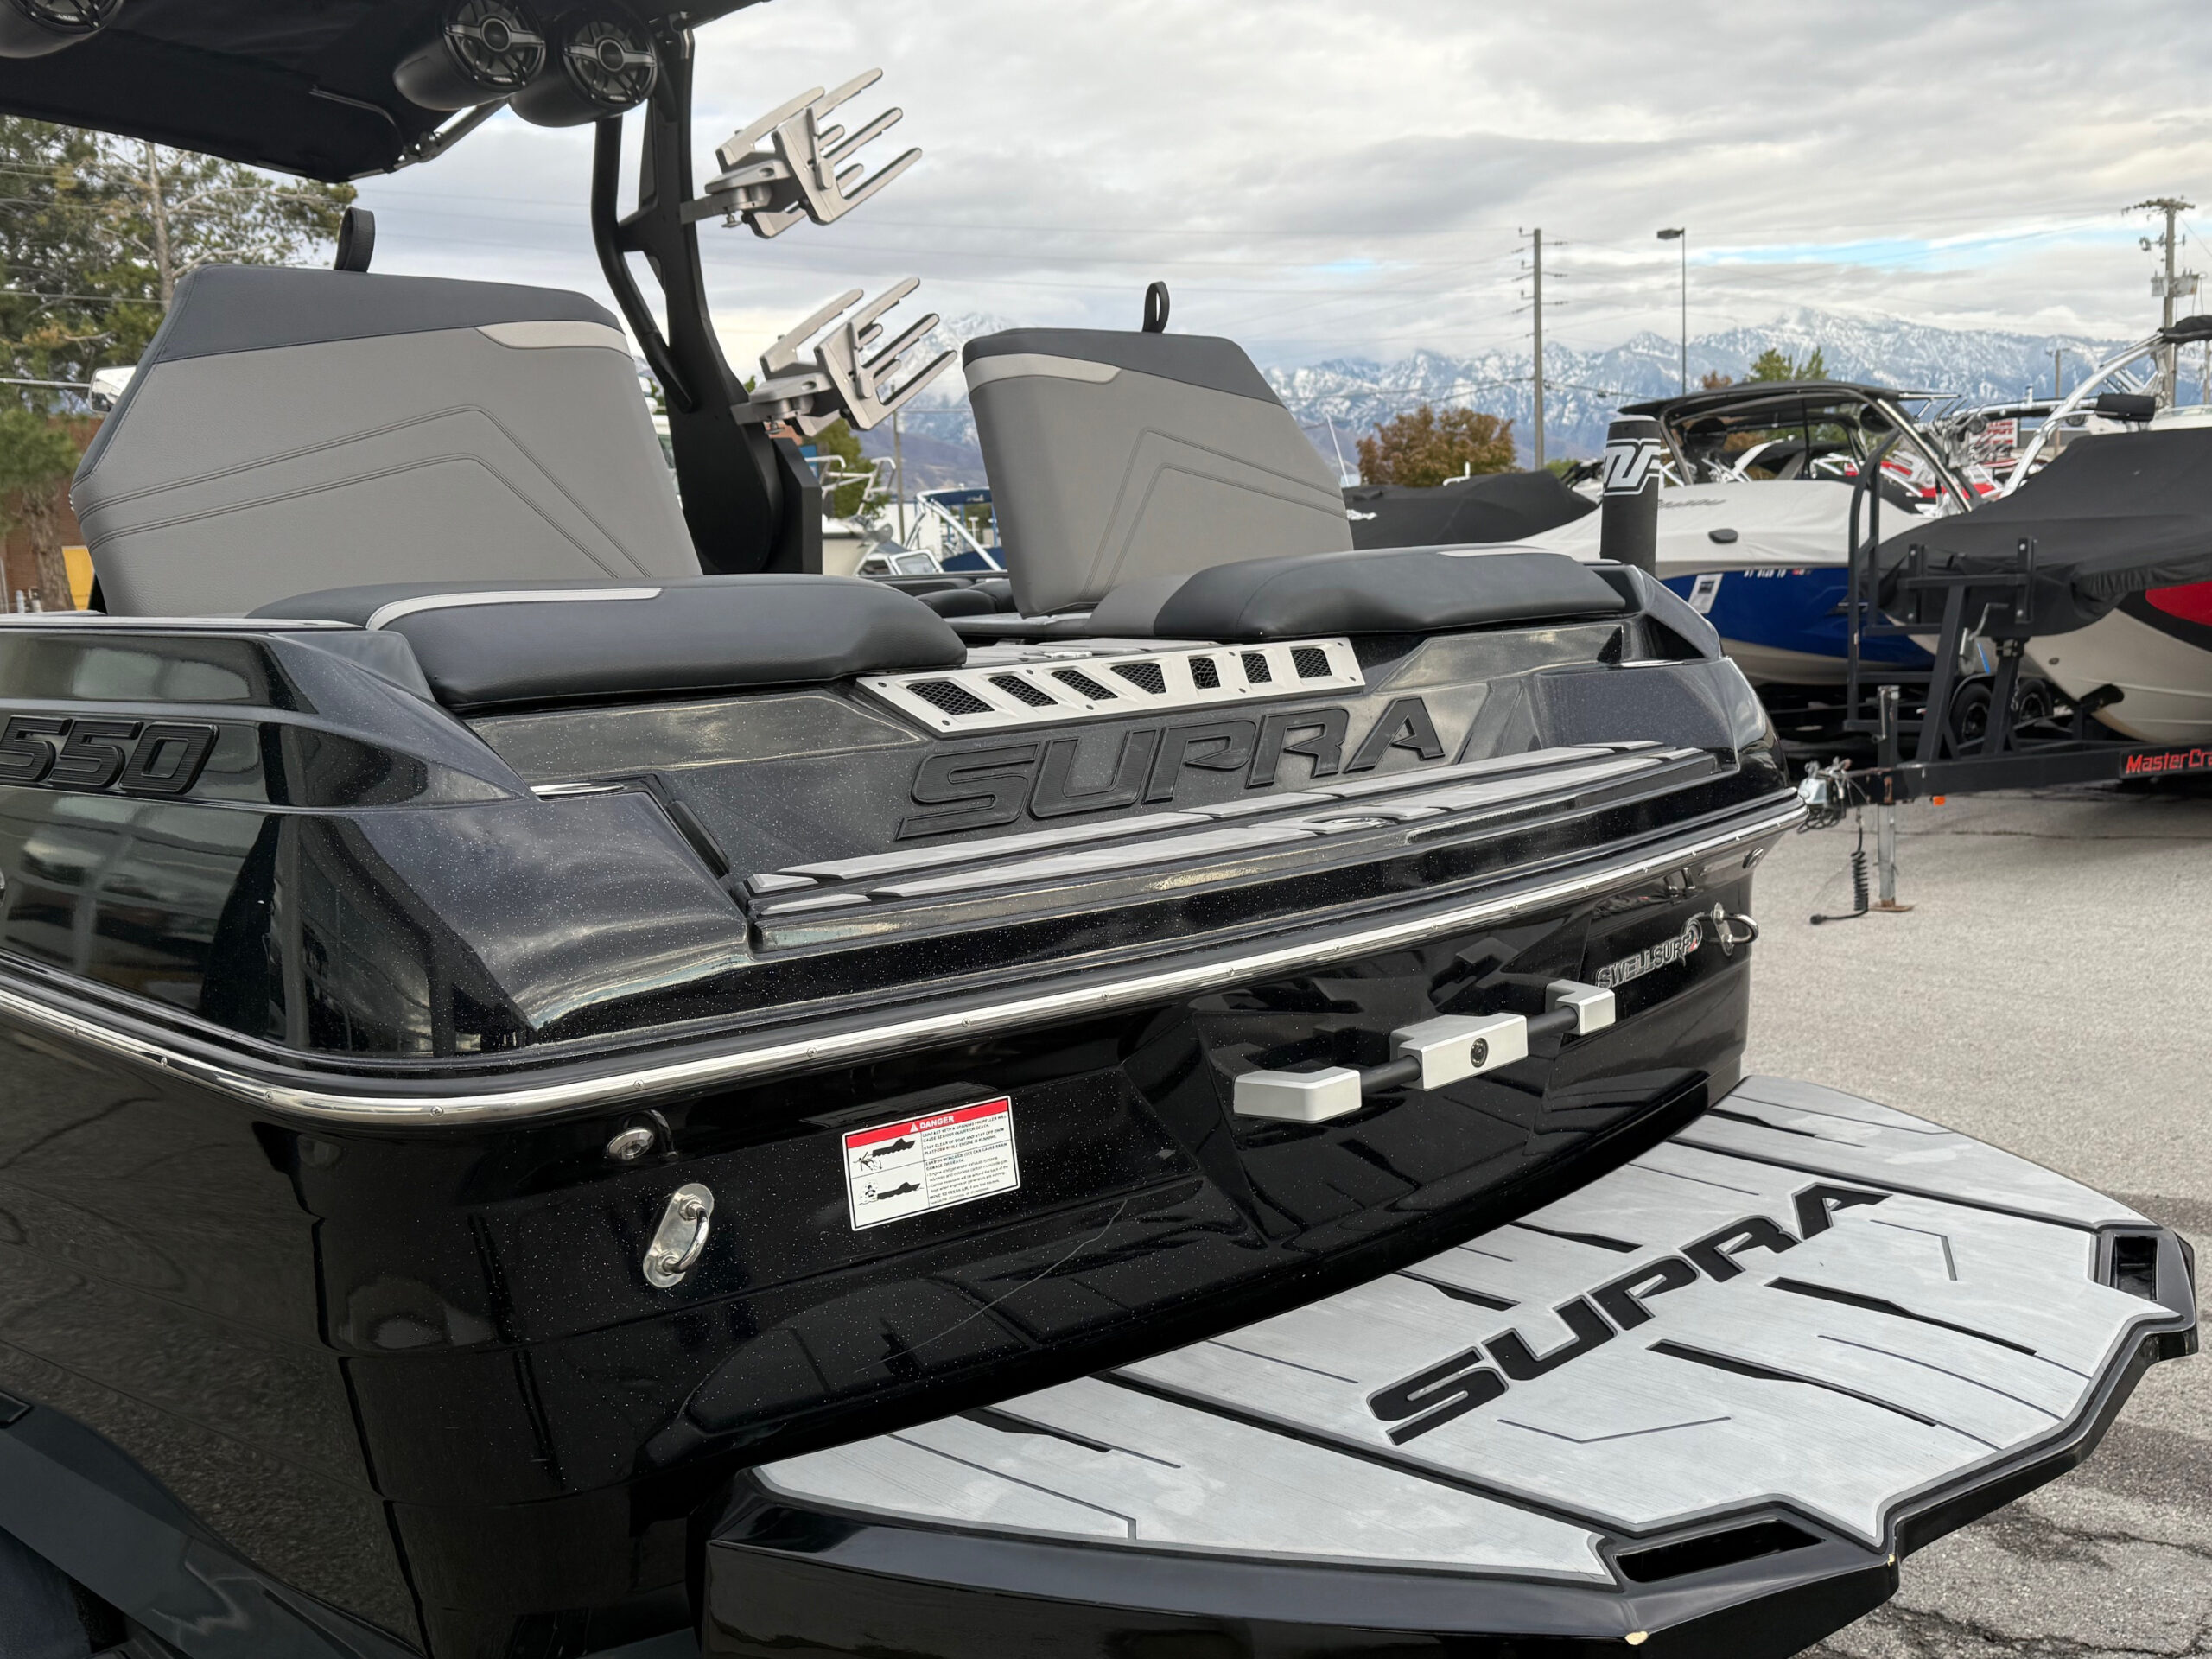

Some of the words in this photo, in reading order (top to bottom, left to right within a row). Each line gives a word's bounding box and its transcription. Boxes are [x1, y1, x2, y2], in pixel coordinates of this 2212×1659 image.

[0, 714, 220, 795] 550
[894, 698, 1446, 842] SUPRA
[1596, 933, 1693, 989] SWELLSURF
[919, 1116, 954, 1129] DANGER
[1366, 1182, 1894, 1446] SUPRA
